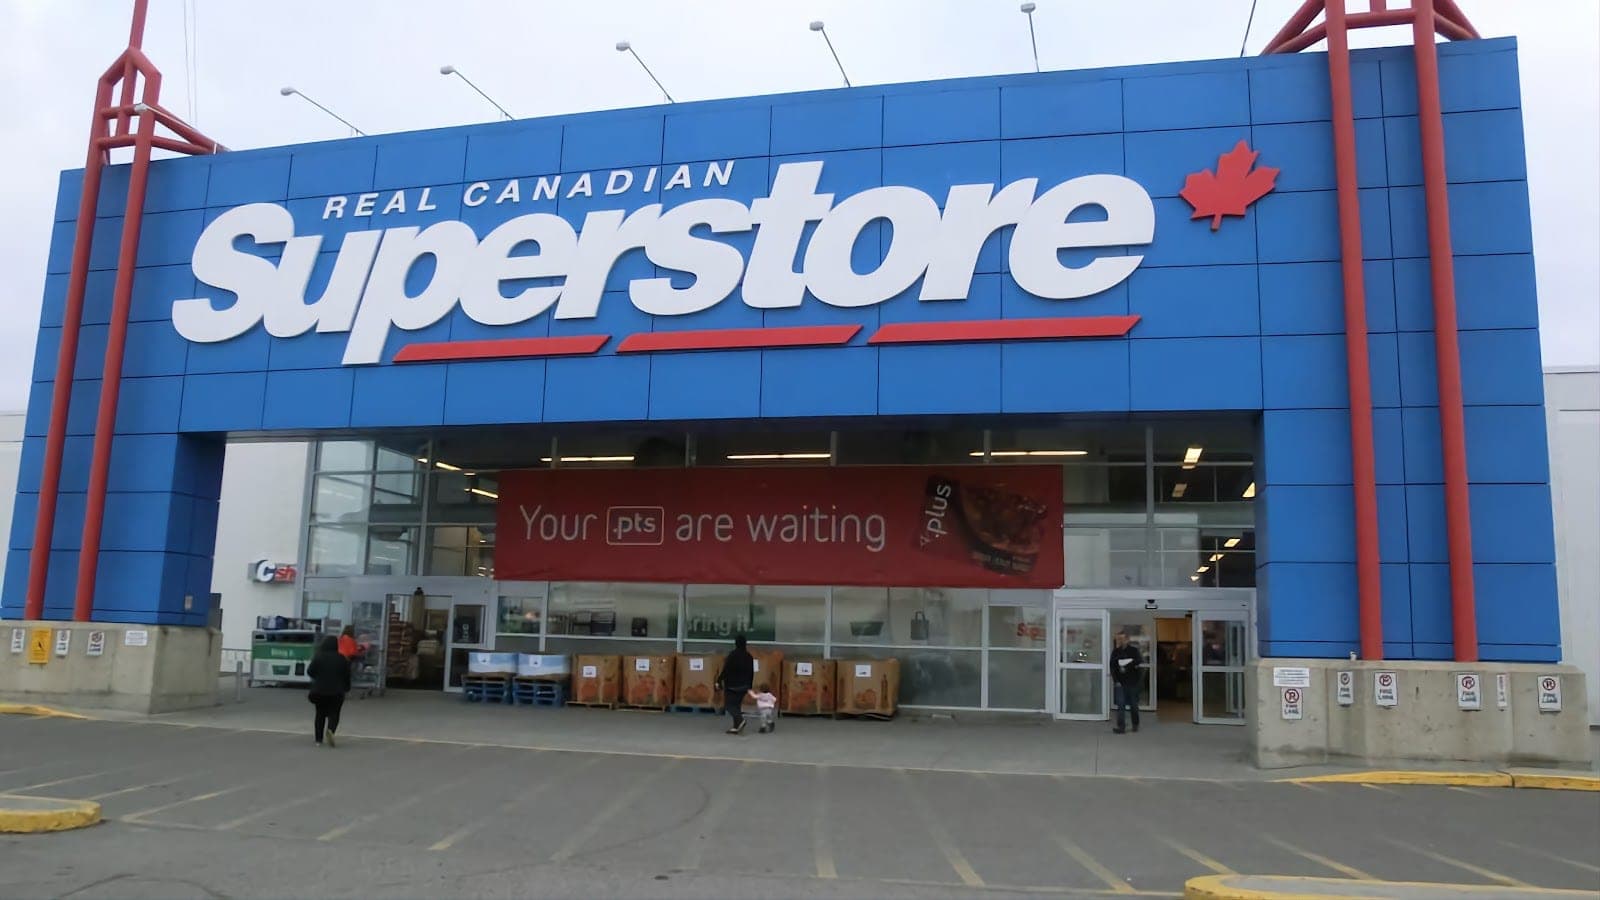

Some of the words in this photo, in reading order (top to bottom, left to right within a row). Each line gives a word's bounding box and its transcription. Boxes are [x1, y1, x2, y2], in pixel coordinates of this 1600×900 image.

[322, 188, 436, 219] REAL
[463, 160, 735, 207] CANADIAN
[171, 160, 1156, 365] Superstore
[519, 505, 598, 541] Your
[676, 514, 734, 542] are
[746, 506, 886, 553] waiting
